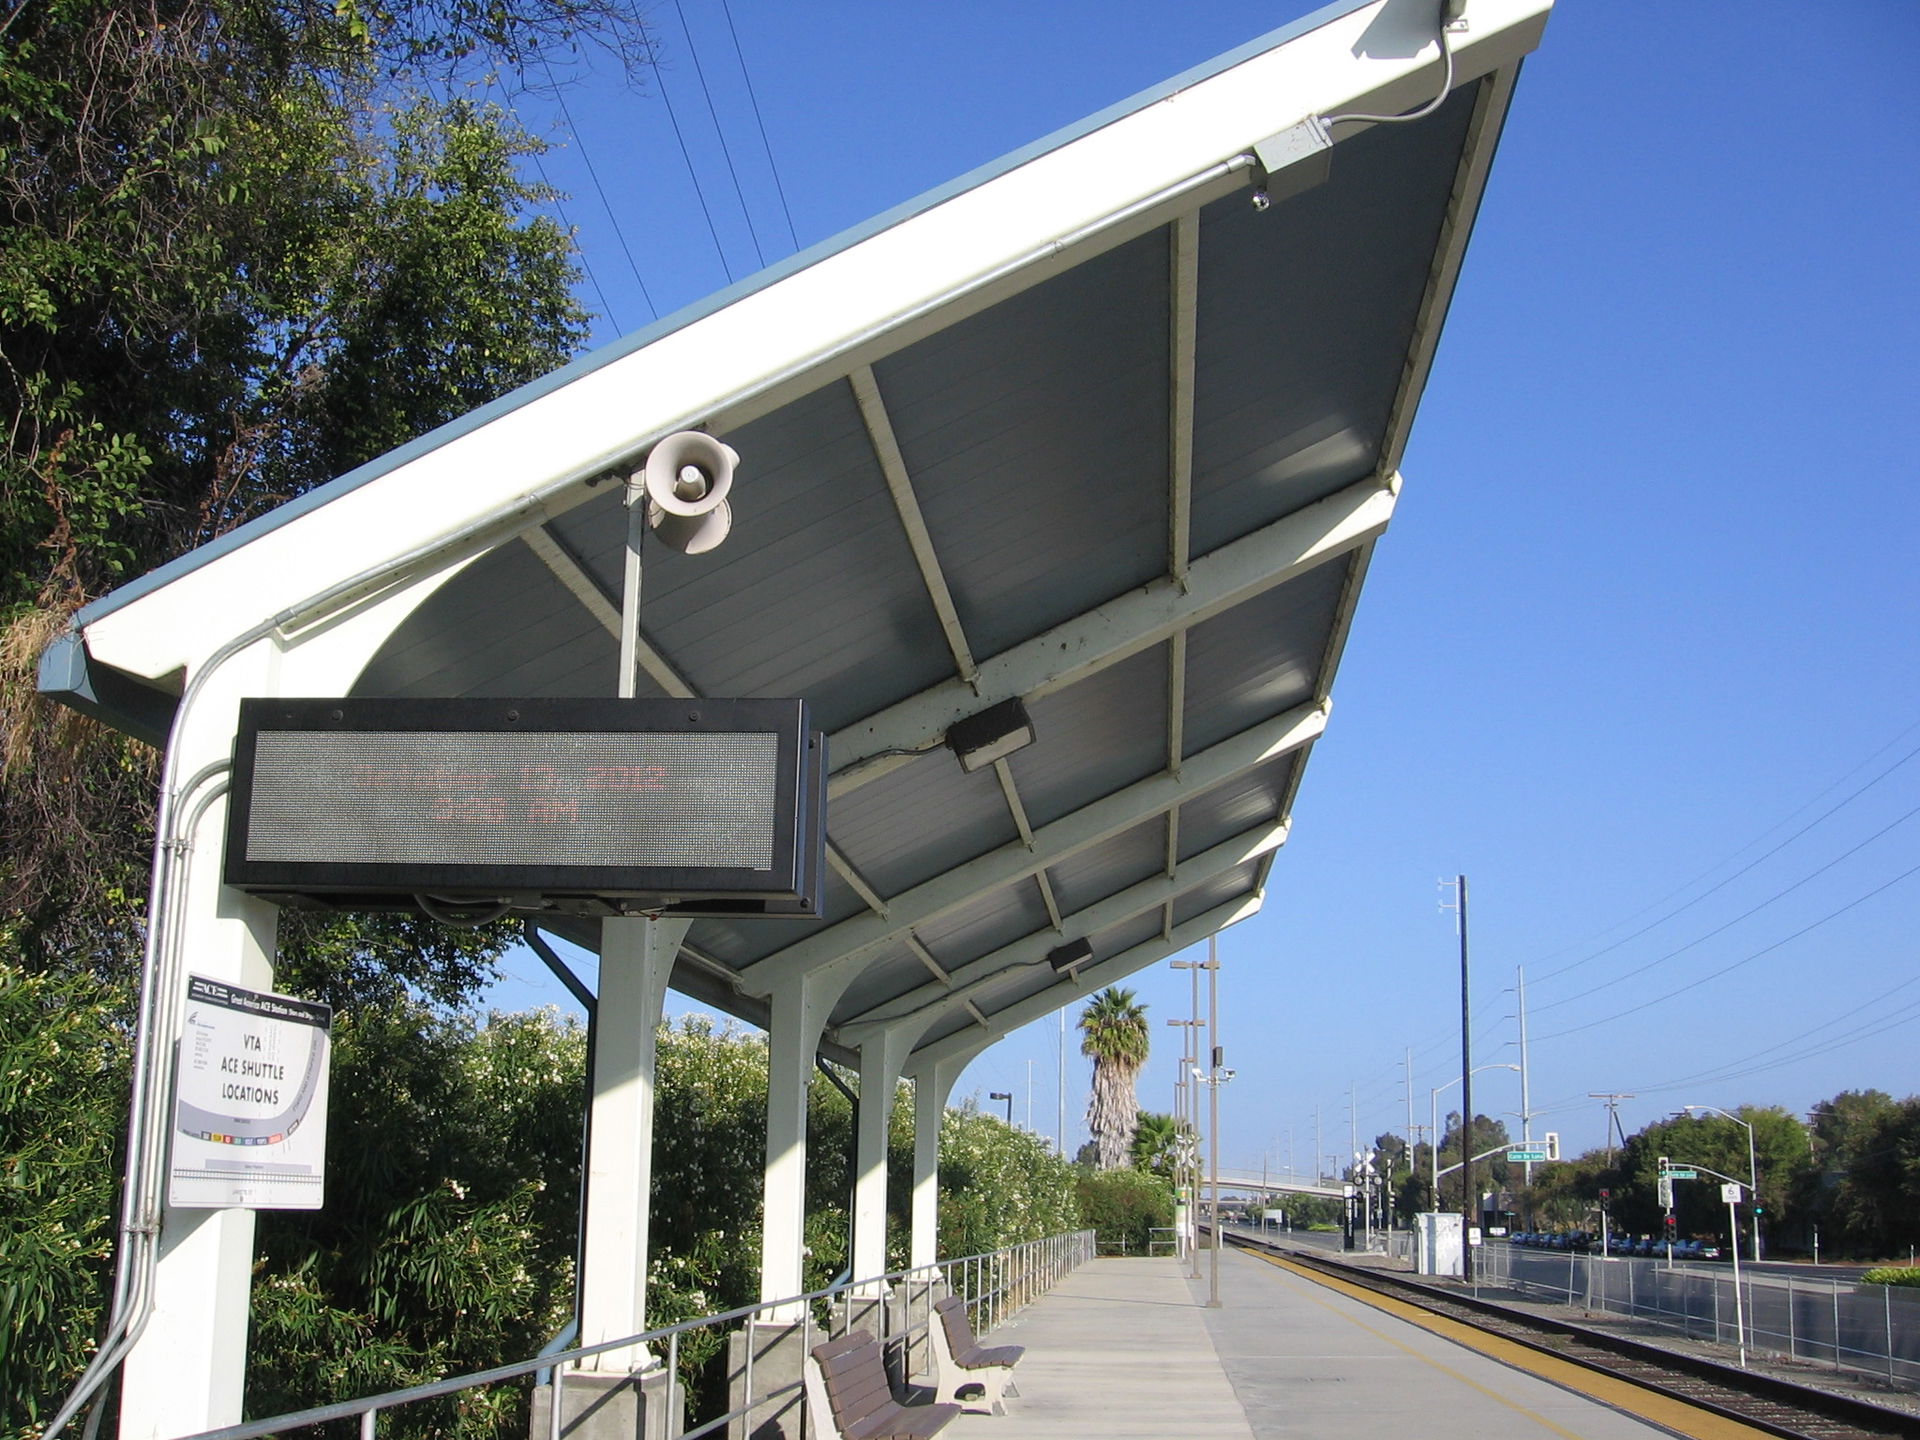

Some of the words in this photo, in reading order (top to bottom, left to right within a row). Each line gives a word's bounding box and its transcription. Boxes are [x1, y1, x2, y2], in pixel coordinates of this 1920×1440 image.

[582, 763, 668, 791] 2012
[526, 797, 581, 824] AM
[260, 1001, 272, 1013] ACE
[243, 1034, 261, 1052] VTA
[221, 1056, 238, 1074] ACE
[241, 1060, 284, 1081] SHUTTLE
[222, 1083, 279, 1105] LOCATIONS
